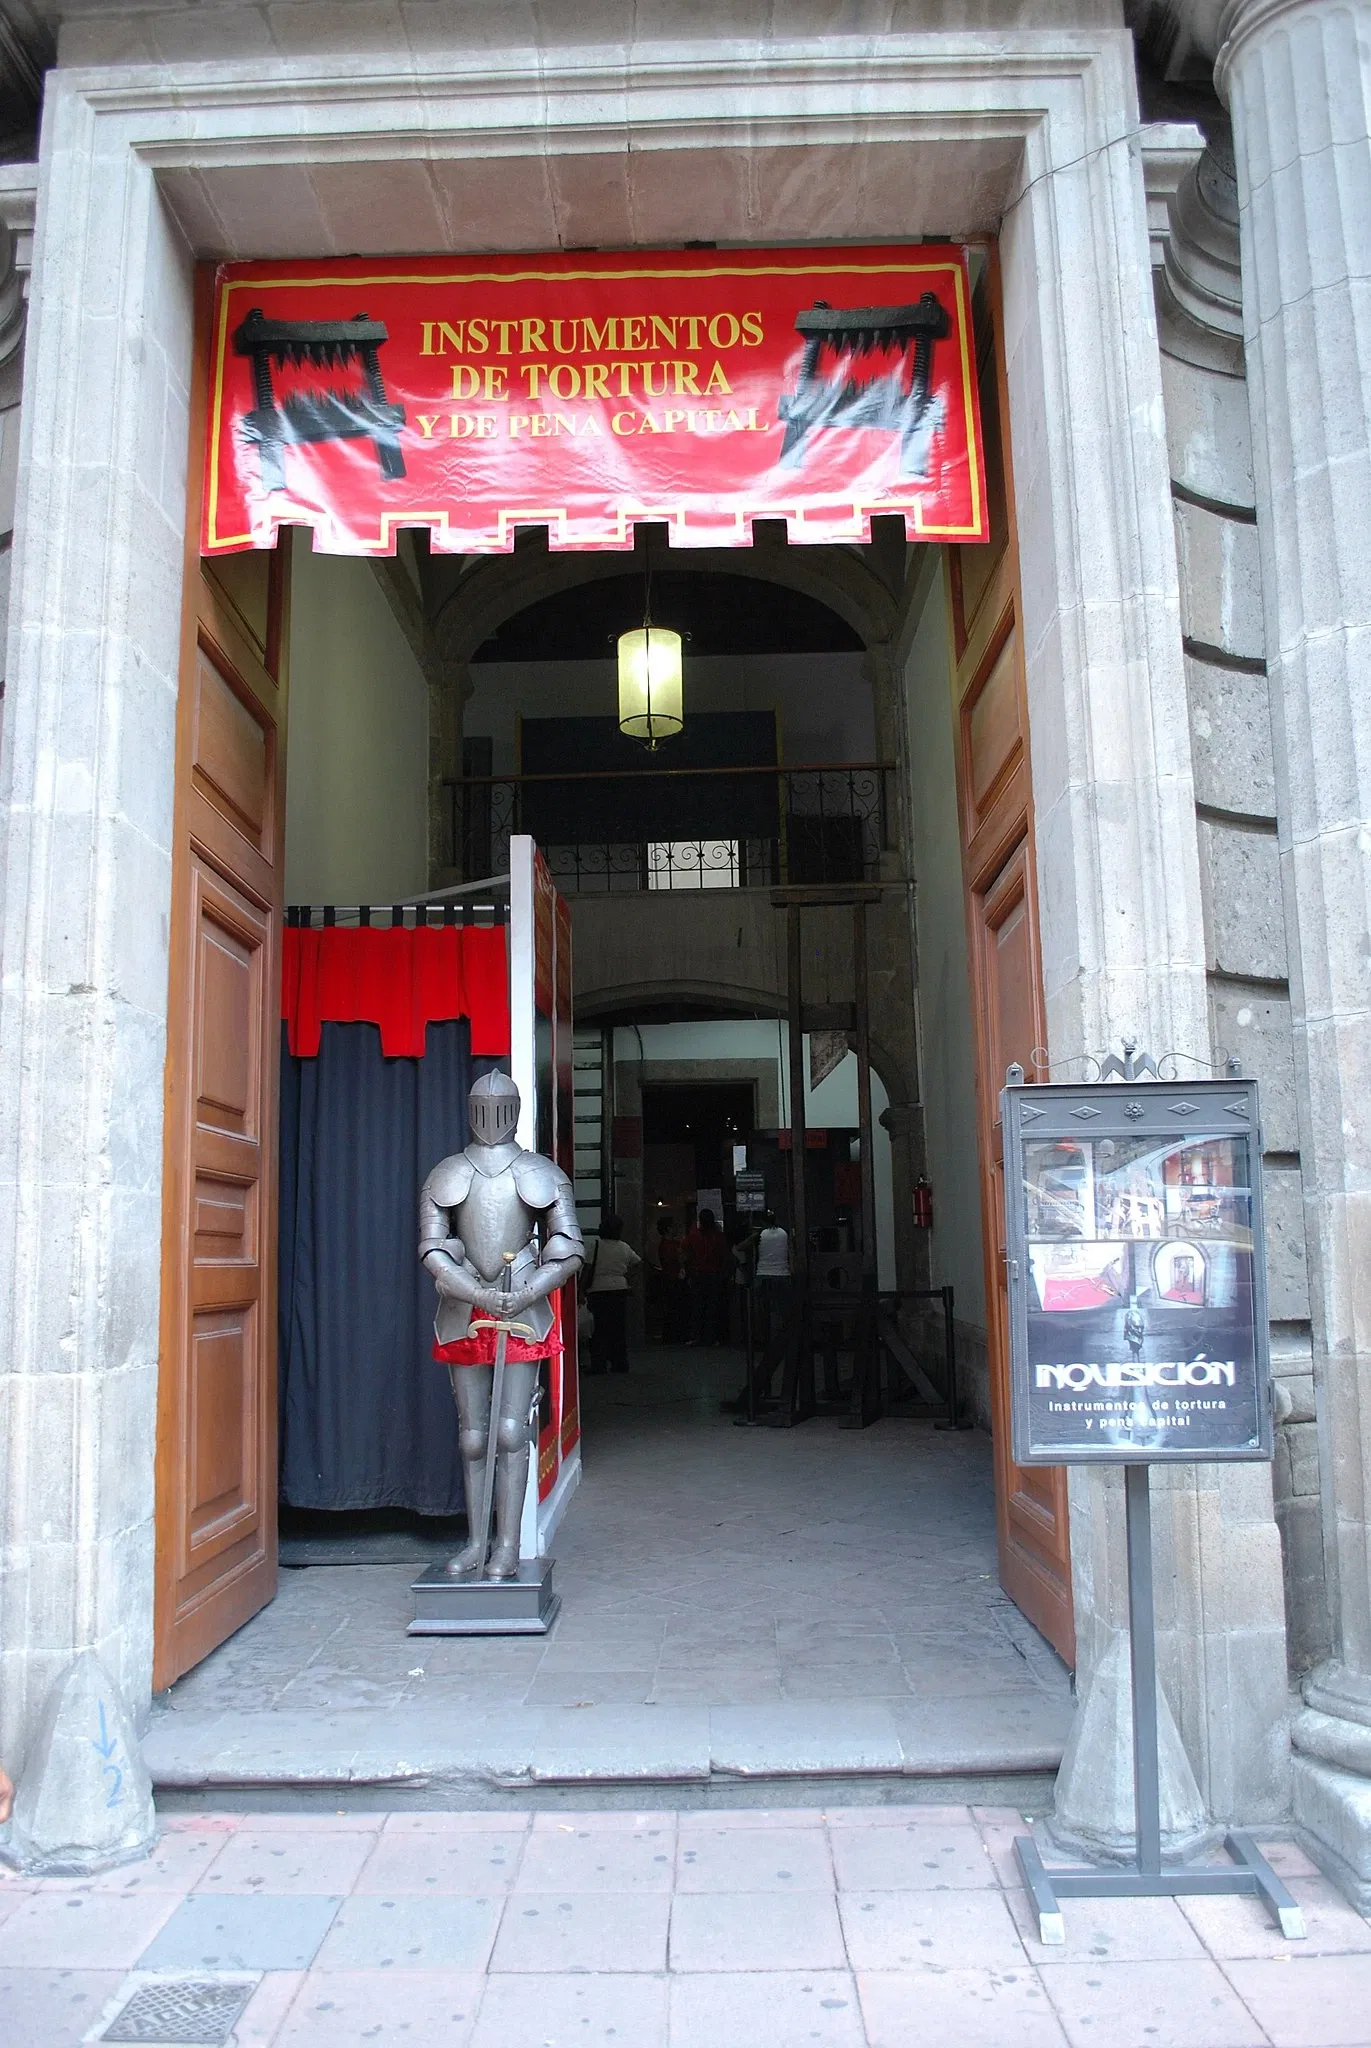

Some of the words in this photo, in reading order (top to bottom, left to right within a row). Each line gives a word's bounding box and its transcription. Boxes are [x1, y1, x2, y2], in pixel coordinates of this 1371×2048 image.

[419, 312, 764, 355] INSTRUMENTOS
[450, 365, 509, 401] DE
[521, 360, 734, 400] TORTURA
[415, 414, 440, 439] Y
[448, 413, 497, 438] DE
[509, 411, 602, 437] PENA
[611, 407, 769, 435] CAPITAL
[1152, 1400, 1169, 1410] de
[1175, 1400, 1226, 1411] tortura
[1085, 1419, 1093, 1429] y
[103, 1764, 124, 1808] 2
